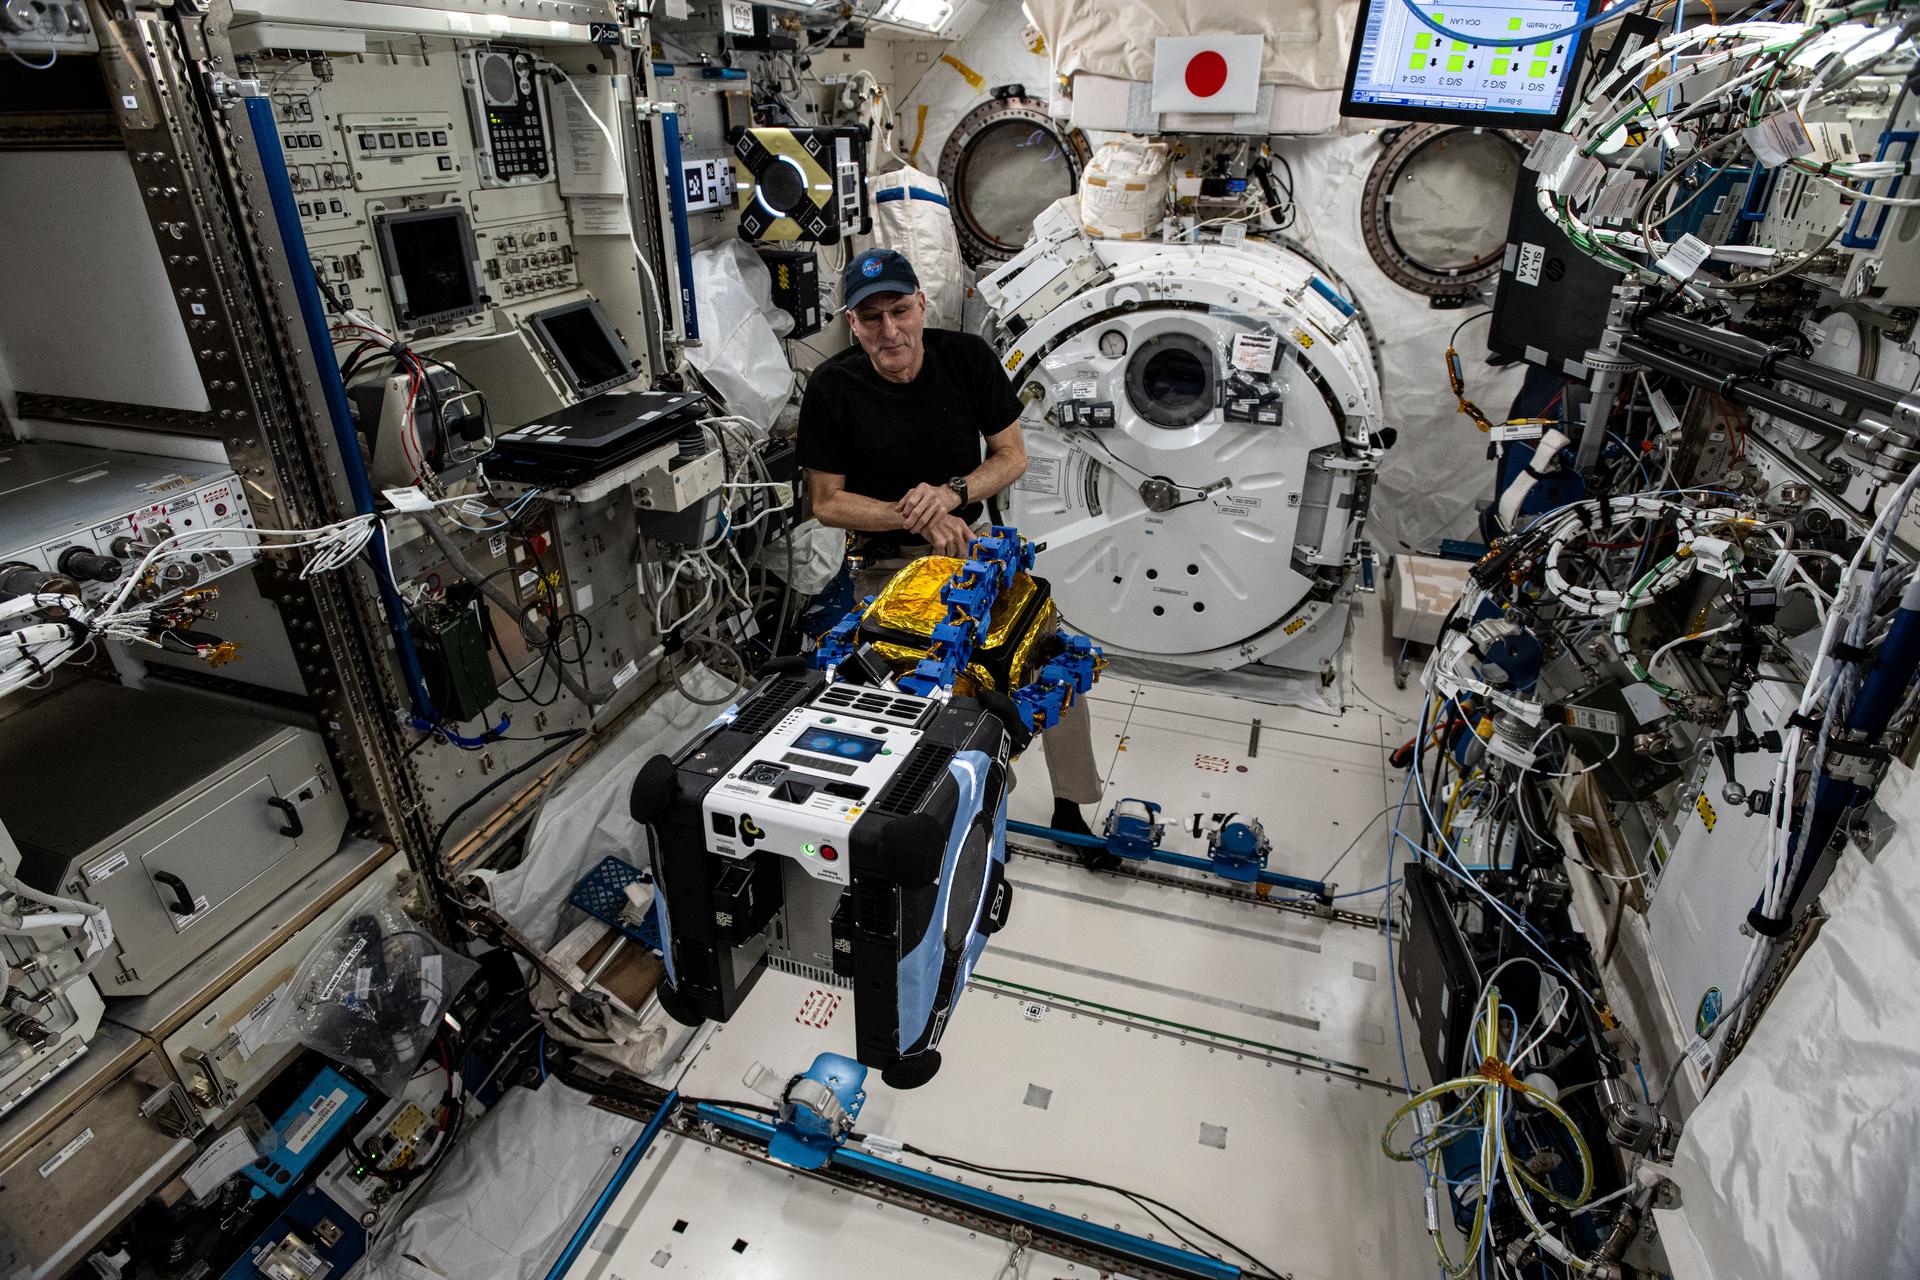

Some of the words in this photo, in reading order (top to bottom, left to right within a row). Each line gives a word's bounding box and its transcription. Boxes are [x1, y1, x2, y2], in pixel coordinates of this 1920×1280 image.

[1526, 22, 1549, 30] Health
[1410, 75, 1426, 84] S/G
[1438, 76, 1445, 85] 3
[1446, 77, 1463, 87] S/G
[1482, 79, 1489, 88] 2
[1490, 80, 1508, 89] S/G
[1528, 82, 1546, 92] S/G
[1498, 97, 1522, 105] S-Band
[1518, 246, 1531, 277] JAXA
[1530, 251, 1542, 280] SLT7
[169, 501, 195, 513] INDICATION
[105, 526, 121, 535] PORT
[46, 540, 73, 553] NITROGEN
